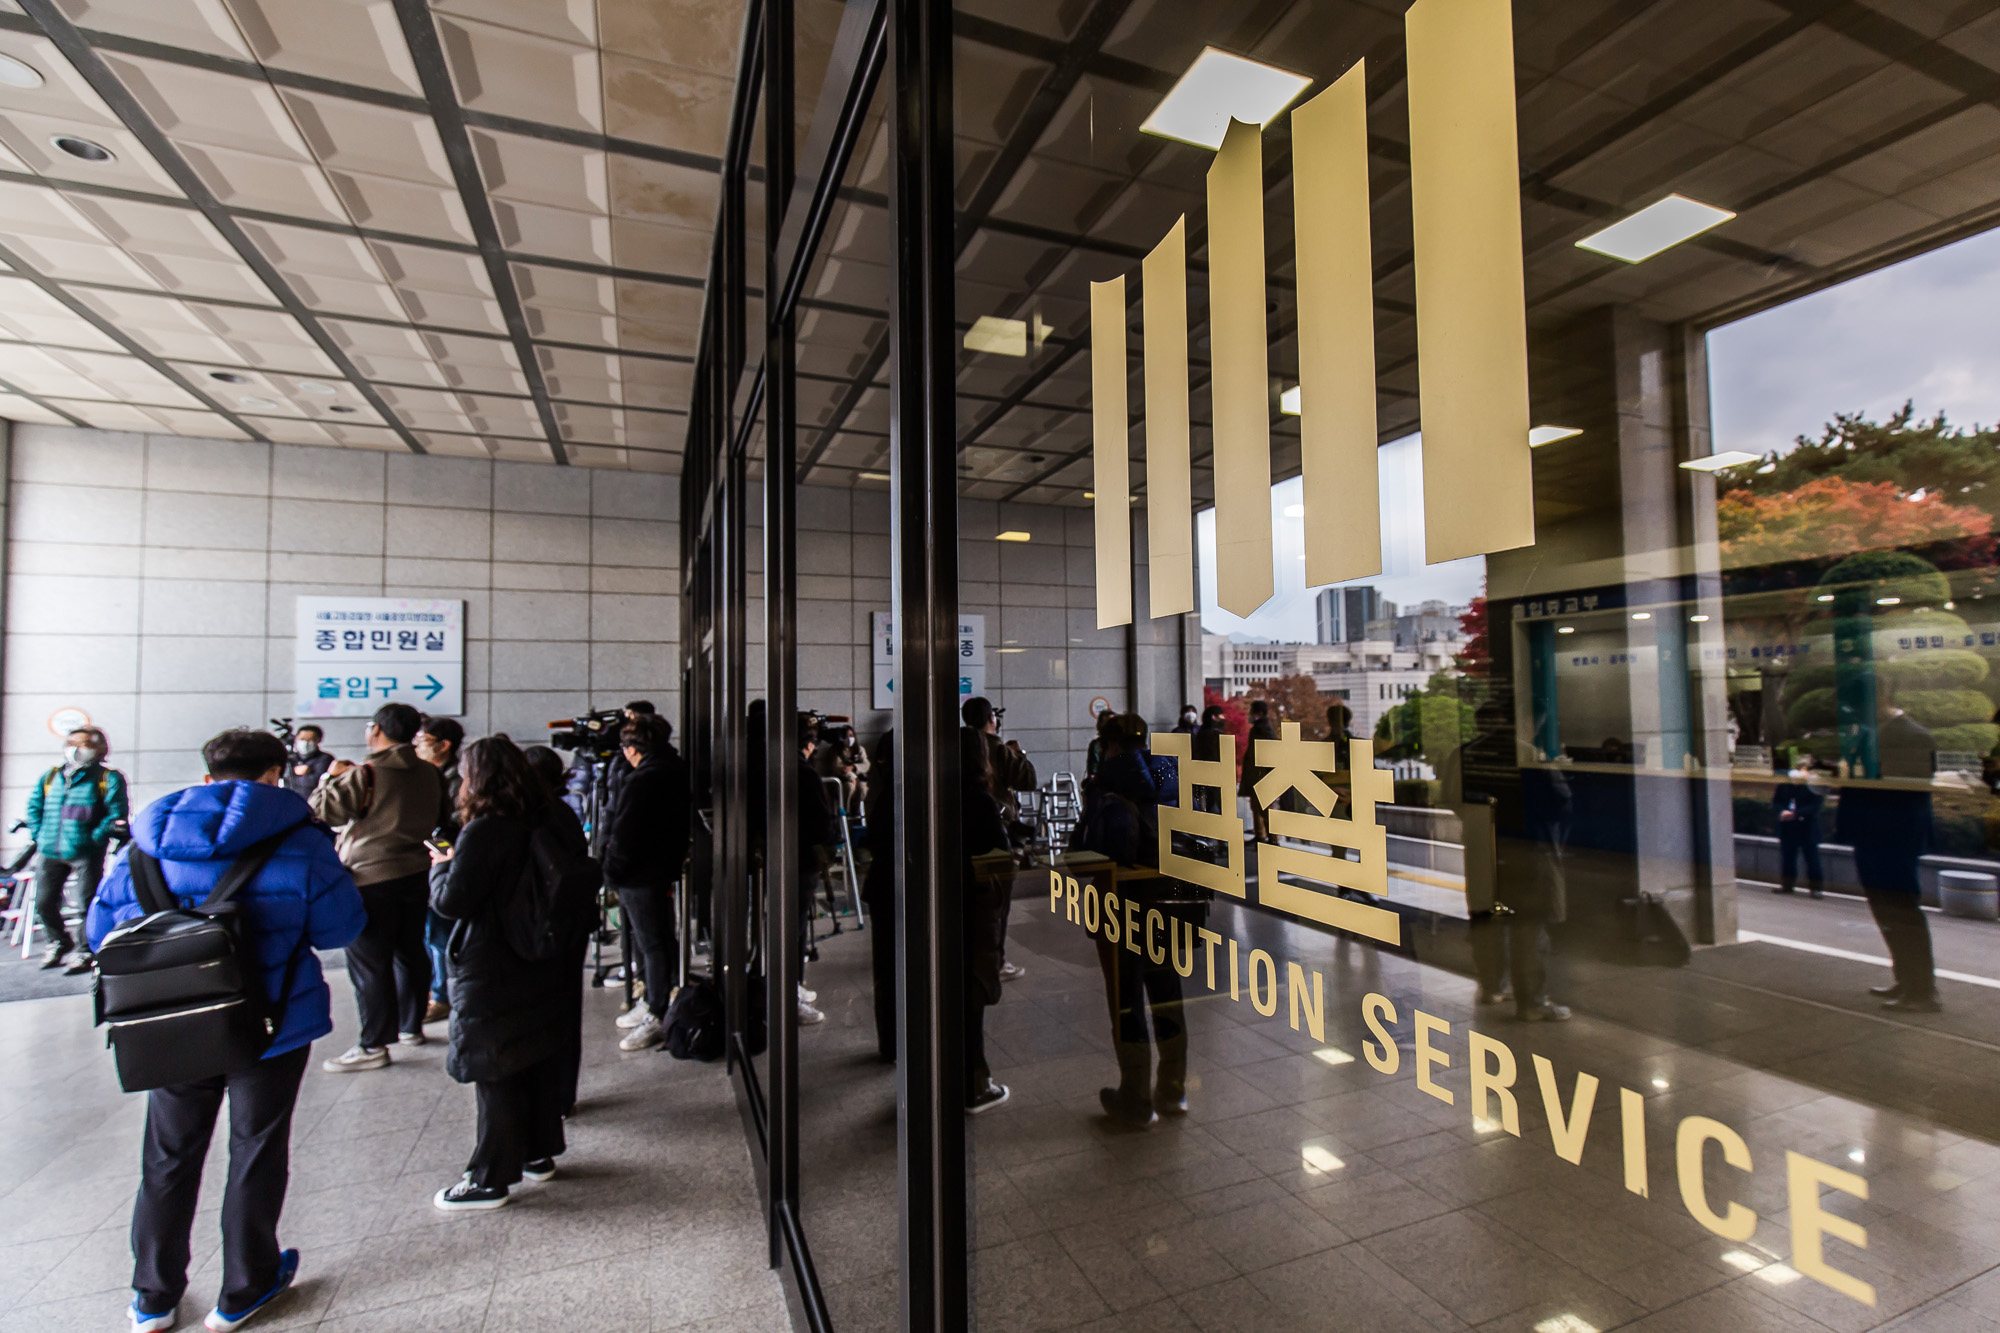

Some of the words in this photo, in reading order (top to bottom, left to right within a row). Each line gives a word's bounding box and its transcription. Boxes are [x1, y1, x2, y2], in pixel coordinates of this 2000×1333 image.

[315, 629, 445, 651] 종합민원실
[318, 677, 398, 698] 출입구
[1150, 721, 1401, 947] 검찰
[1049, 869, 1325, 1044] PROSECUTION
[1361, 992, 1877, 1308] SERVICE
